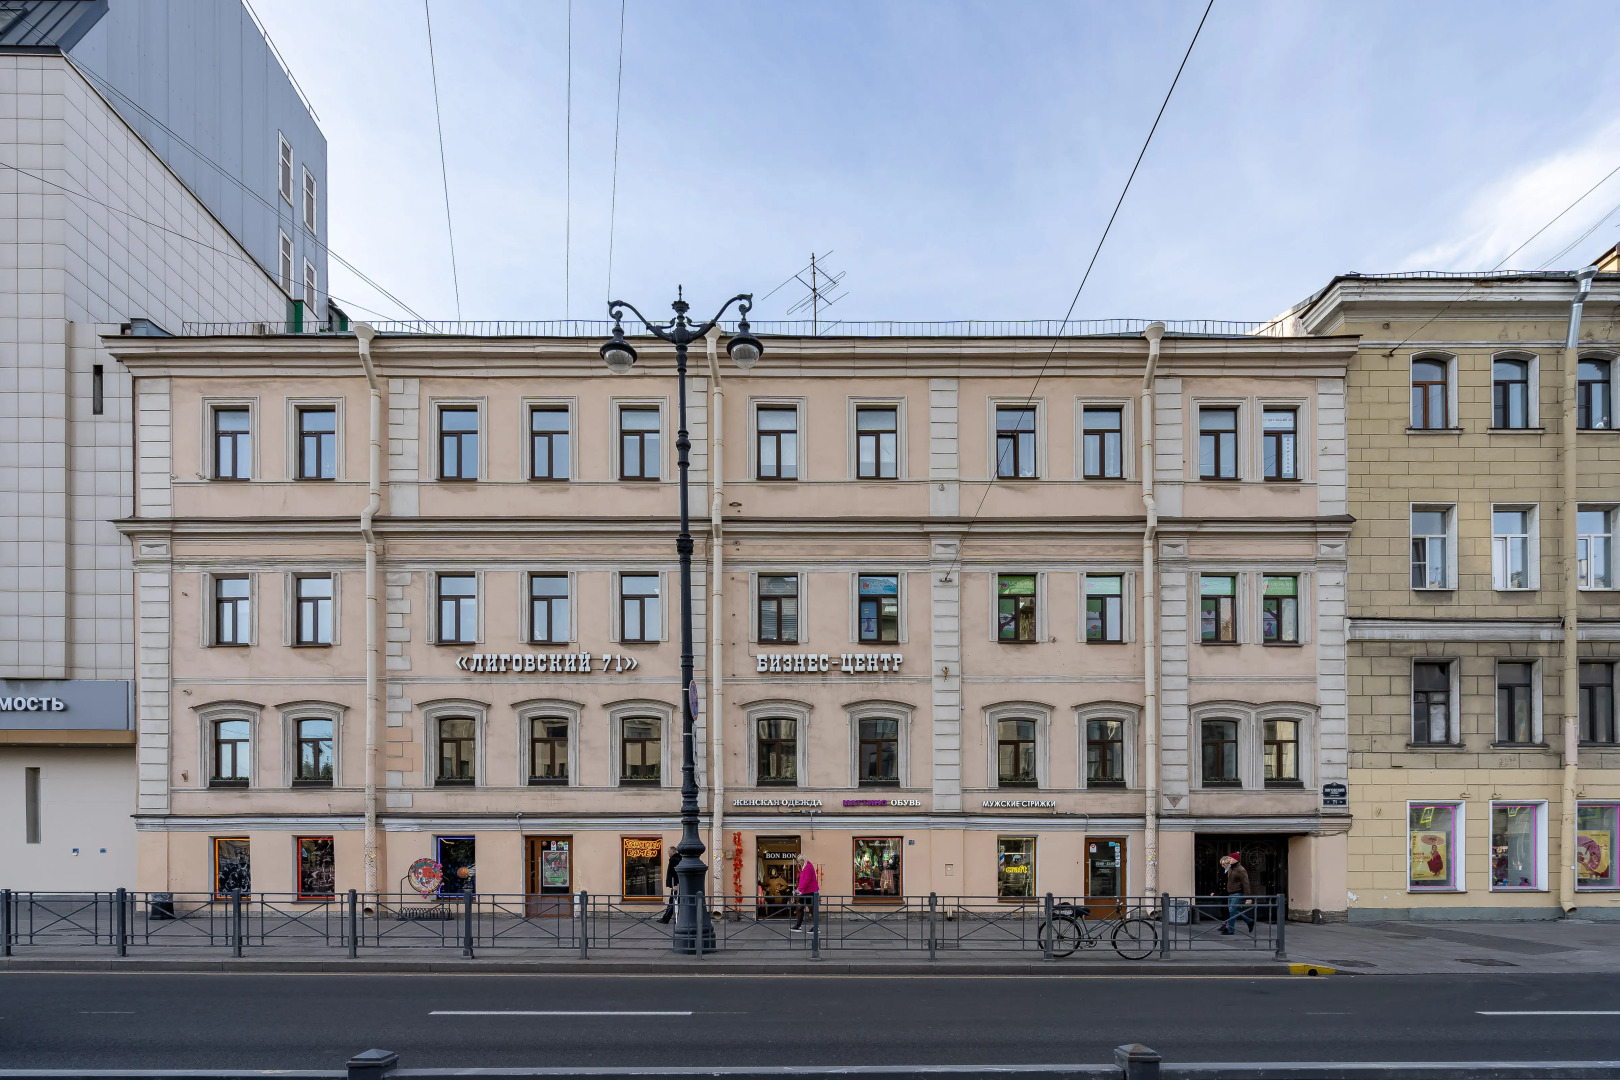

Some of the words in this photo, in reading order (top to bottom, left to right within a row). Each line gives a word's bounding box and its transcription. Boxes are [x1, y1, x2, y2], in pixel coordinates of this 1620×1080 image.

[733, 799, 780, 807] ЖЕНСКАЯ
[781, 799, 823, 808] ОДЕЖДА
[890, 799, 921, 807] ОБУВЬ
[982, 800, 1021, 808] МУЖСКИЕ
[1021, 800, 1056, 808] СТРИЖКИ
